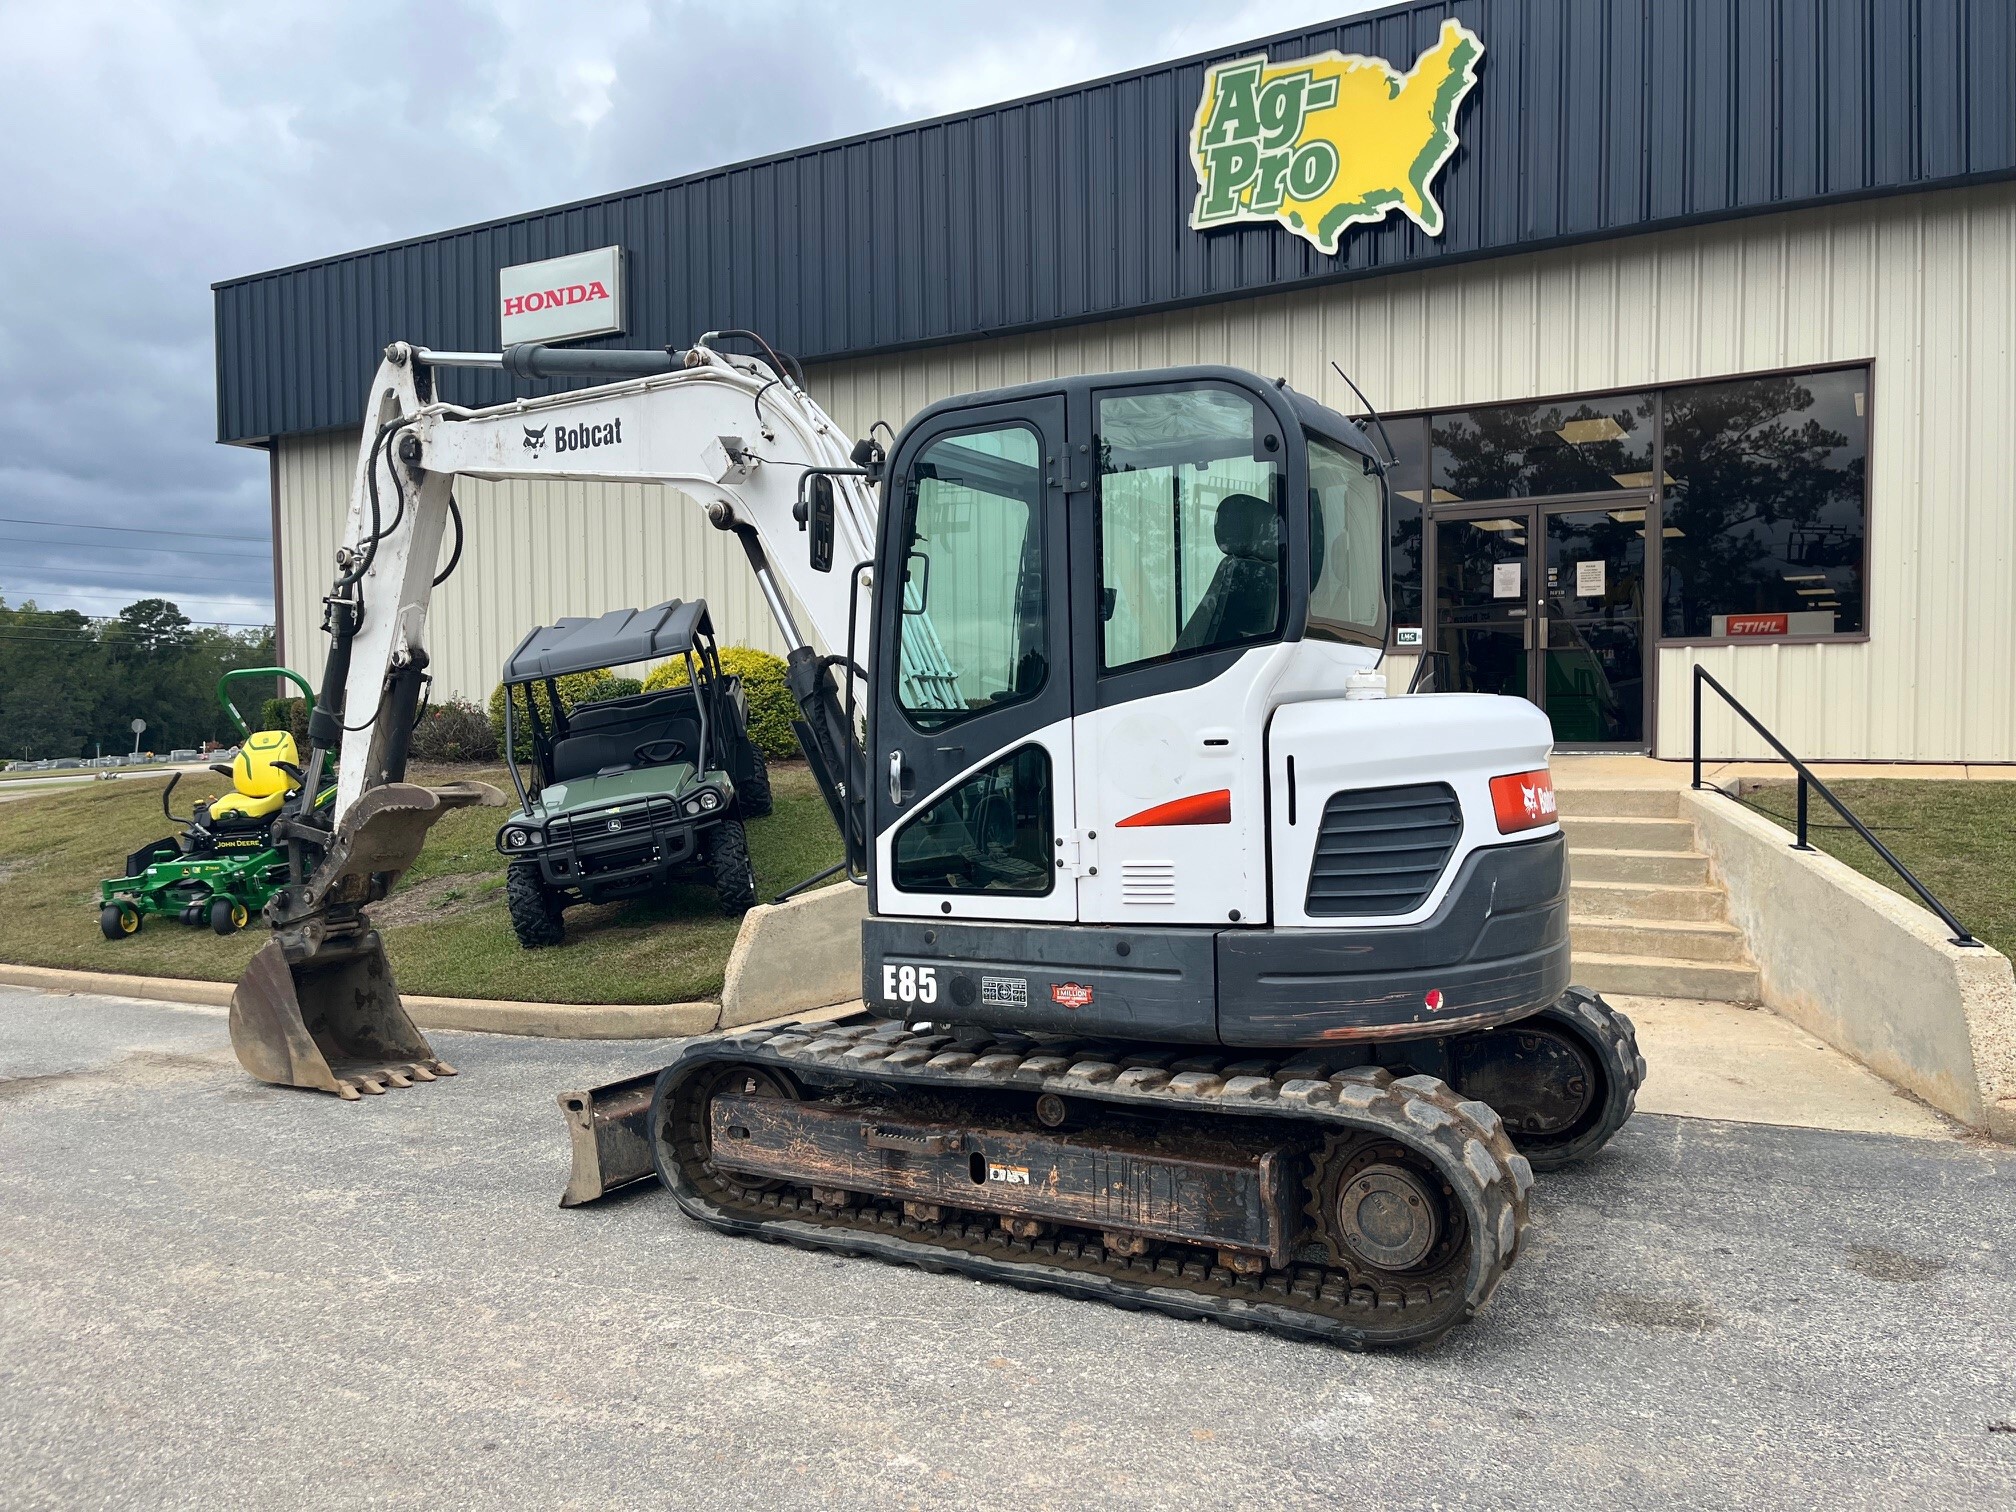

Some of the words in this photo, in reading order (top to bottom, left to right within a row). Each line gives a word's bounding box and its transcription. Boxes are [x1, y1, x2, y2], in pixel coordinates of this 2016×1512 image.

[1201, 63, 1338, 151] Ag-
[1199, 140, 1338, 220] Pro
[503, 280, 610, 317] HONDA
[554, 416, 622, 453] Bobcat
[1730, 620, 1780, 634] STIHL
[882, 964, 938, 1004] E85
[1060, 989, 1087, 998] MILLION
